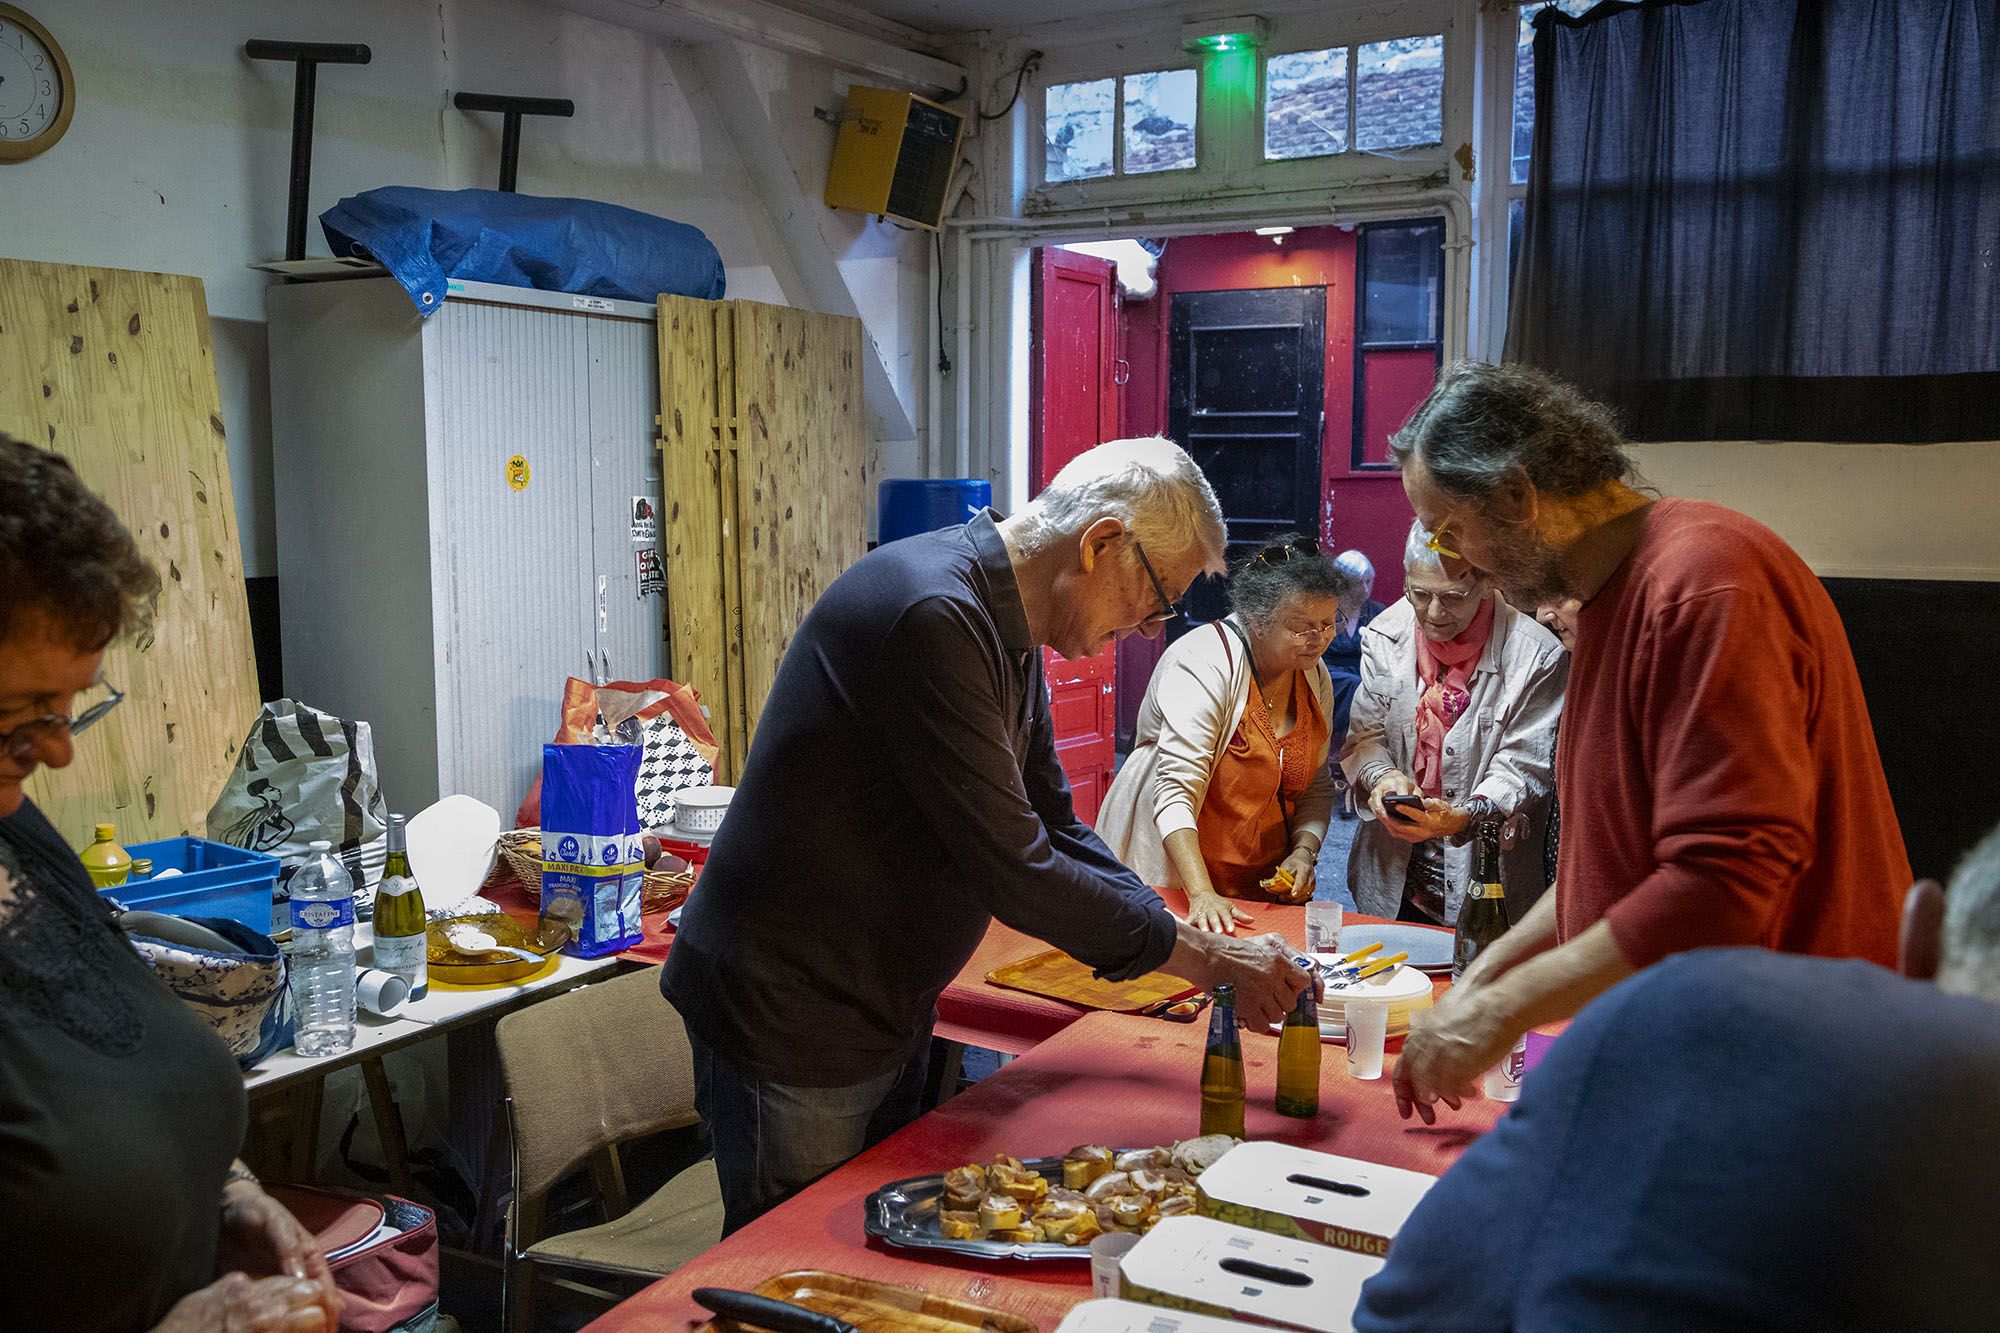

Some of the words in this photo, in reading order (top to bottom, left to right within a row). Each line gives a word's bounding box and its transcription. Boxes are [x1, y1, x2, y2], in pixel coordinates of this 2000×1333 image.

[18, 33, 24, 51] 1
[34, 54, 44, 71] 2
[41, 79, 52, 97] 3
[36, 103, 46, 120] 4
[19, 118, 30, 135] 5
[547, 862, 569, 871] MAXI
[1325, 1228, 1386, 1255] ROUGE
